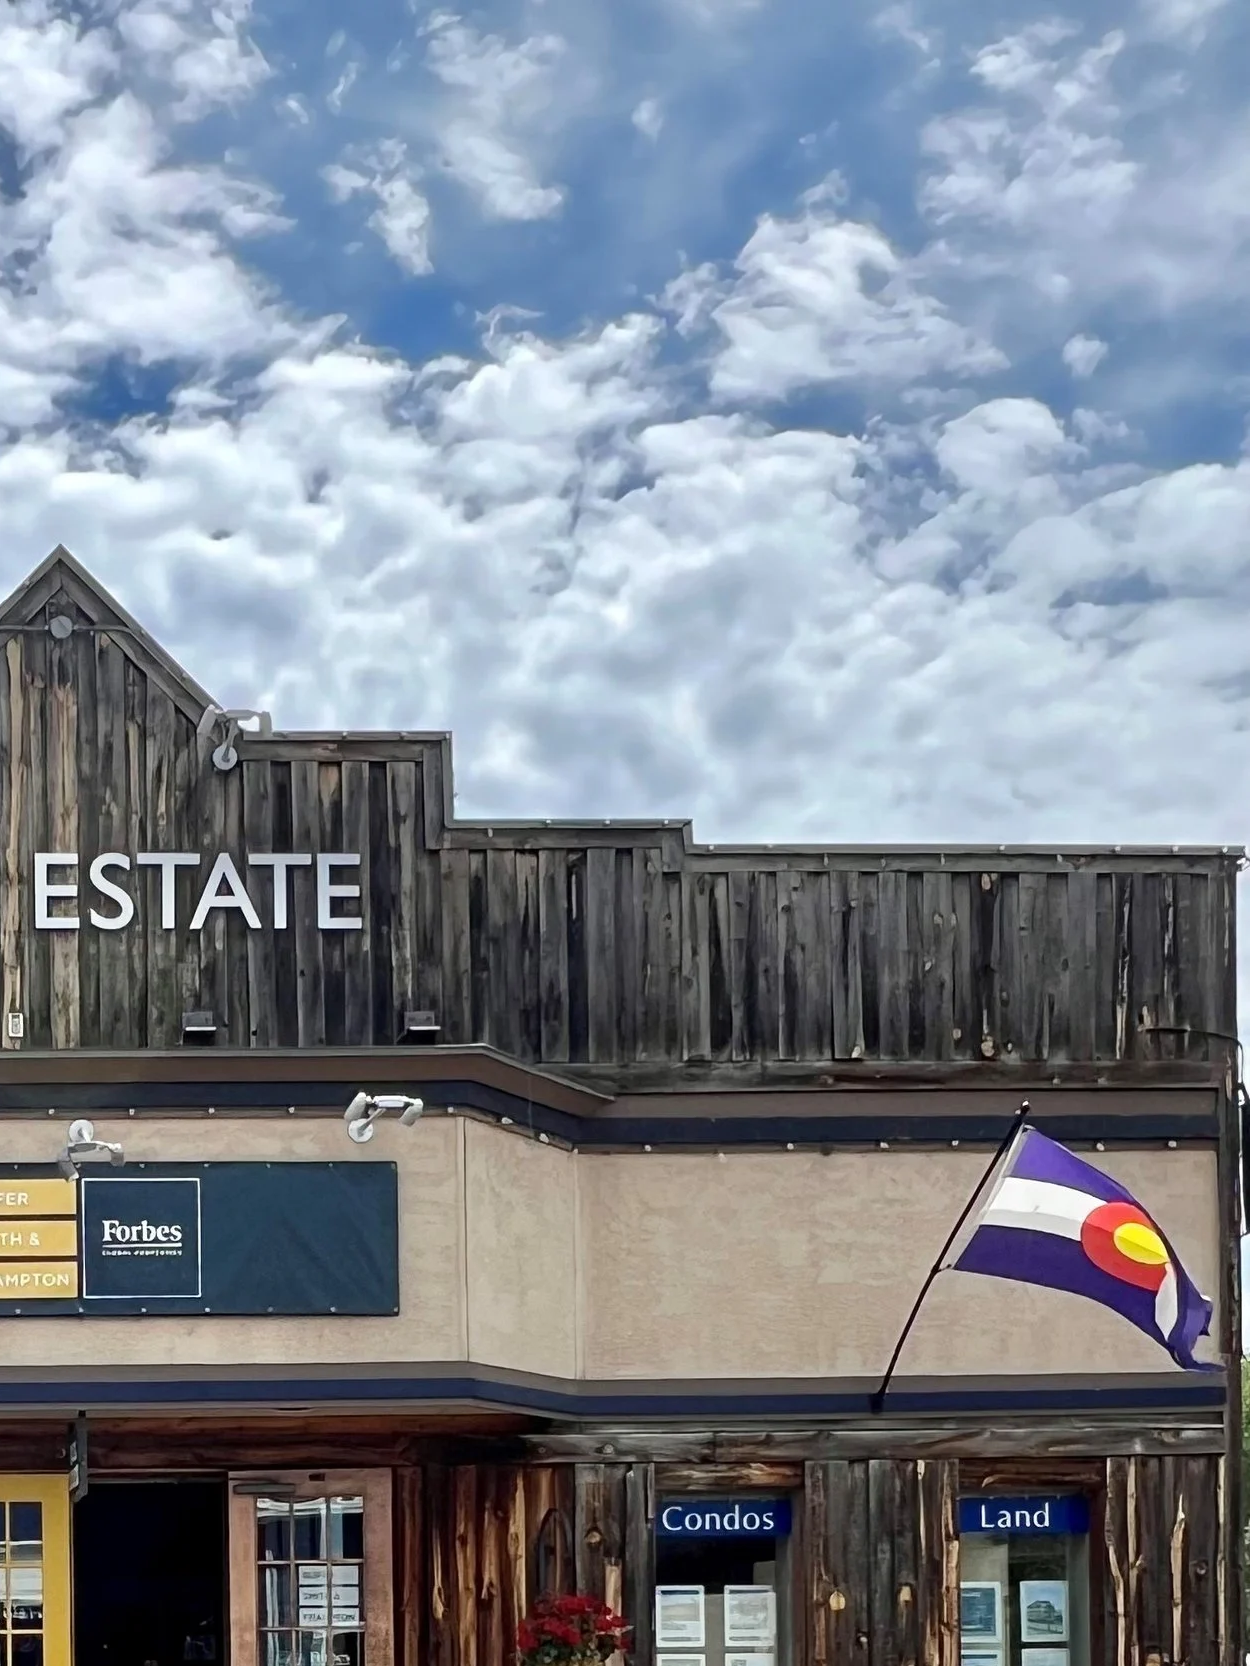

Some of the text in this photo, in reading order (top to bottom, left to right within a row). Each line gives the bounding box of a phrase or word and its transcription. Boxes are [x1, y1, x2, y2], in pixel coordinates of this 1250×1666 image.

[34, 851, 364, 930] ESTATE
[29, 1231, 40, 1246] &
[101, 1219, 183, 1242] Forbes
[661, 1504, 775, 1532] Condos
[980, 1502, 1051, 1529] Land
